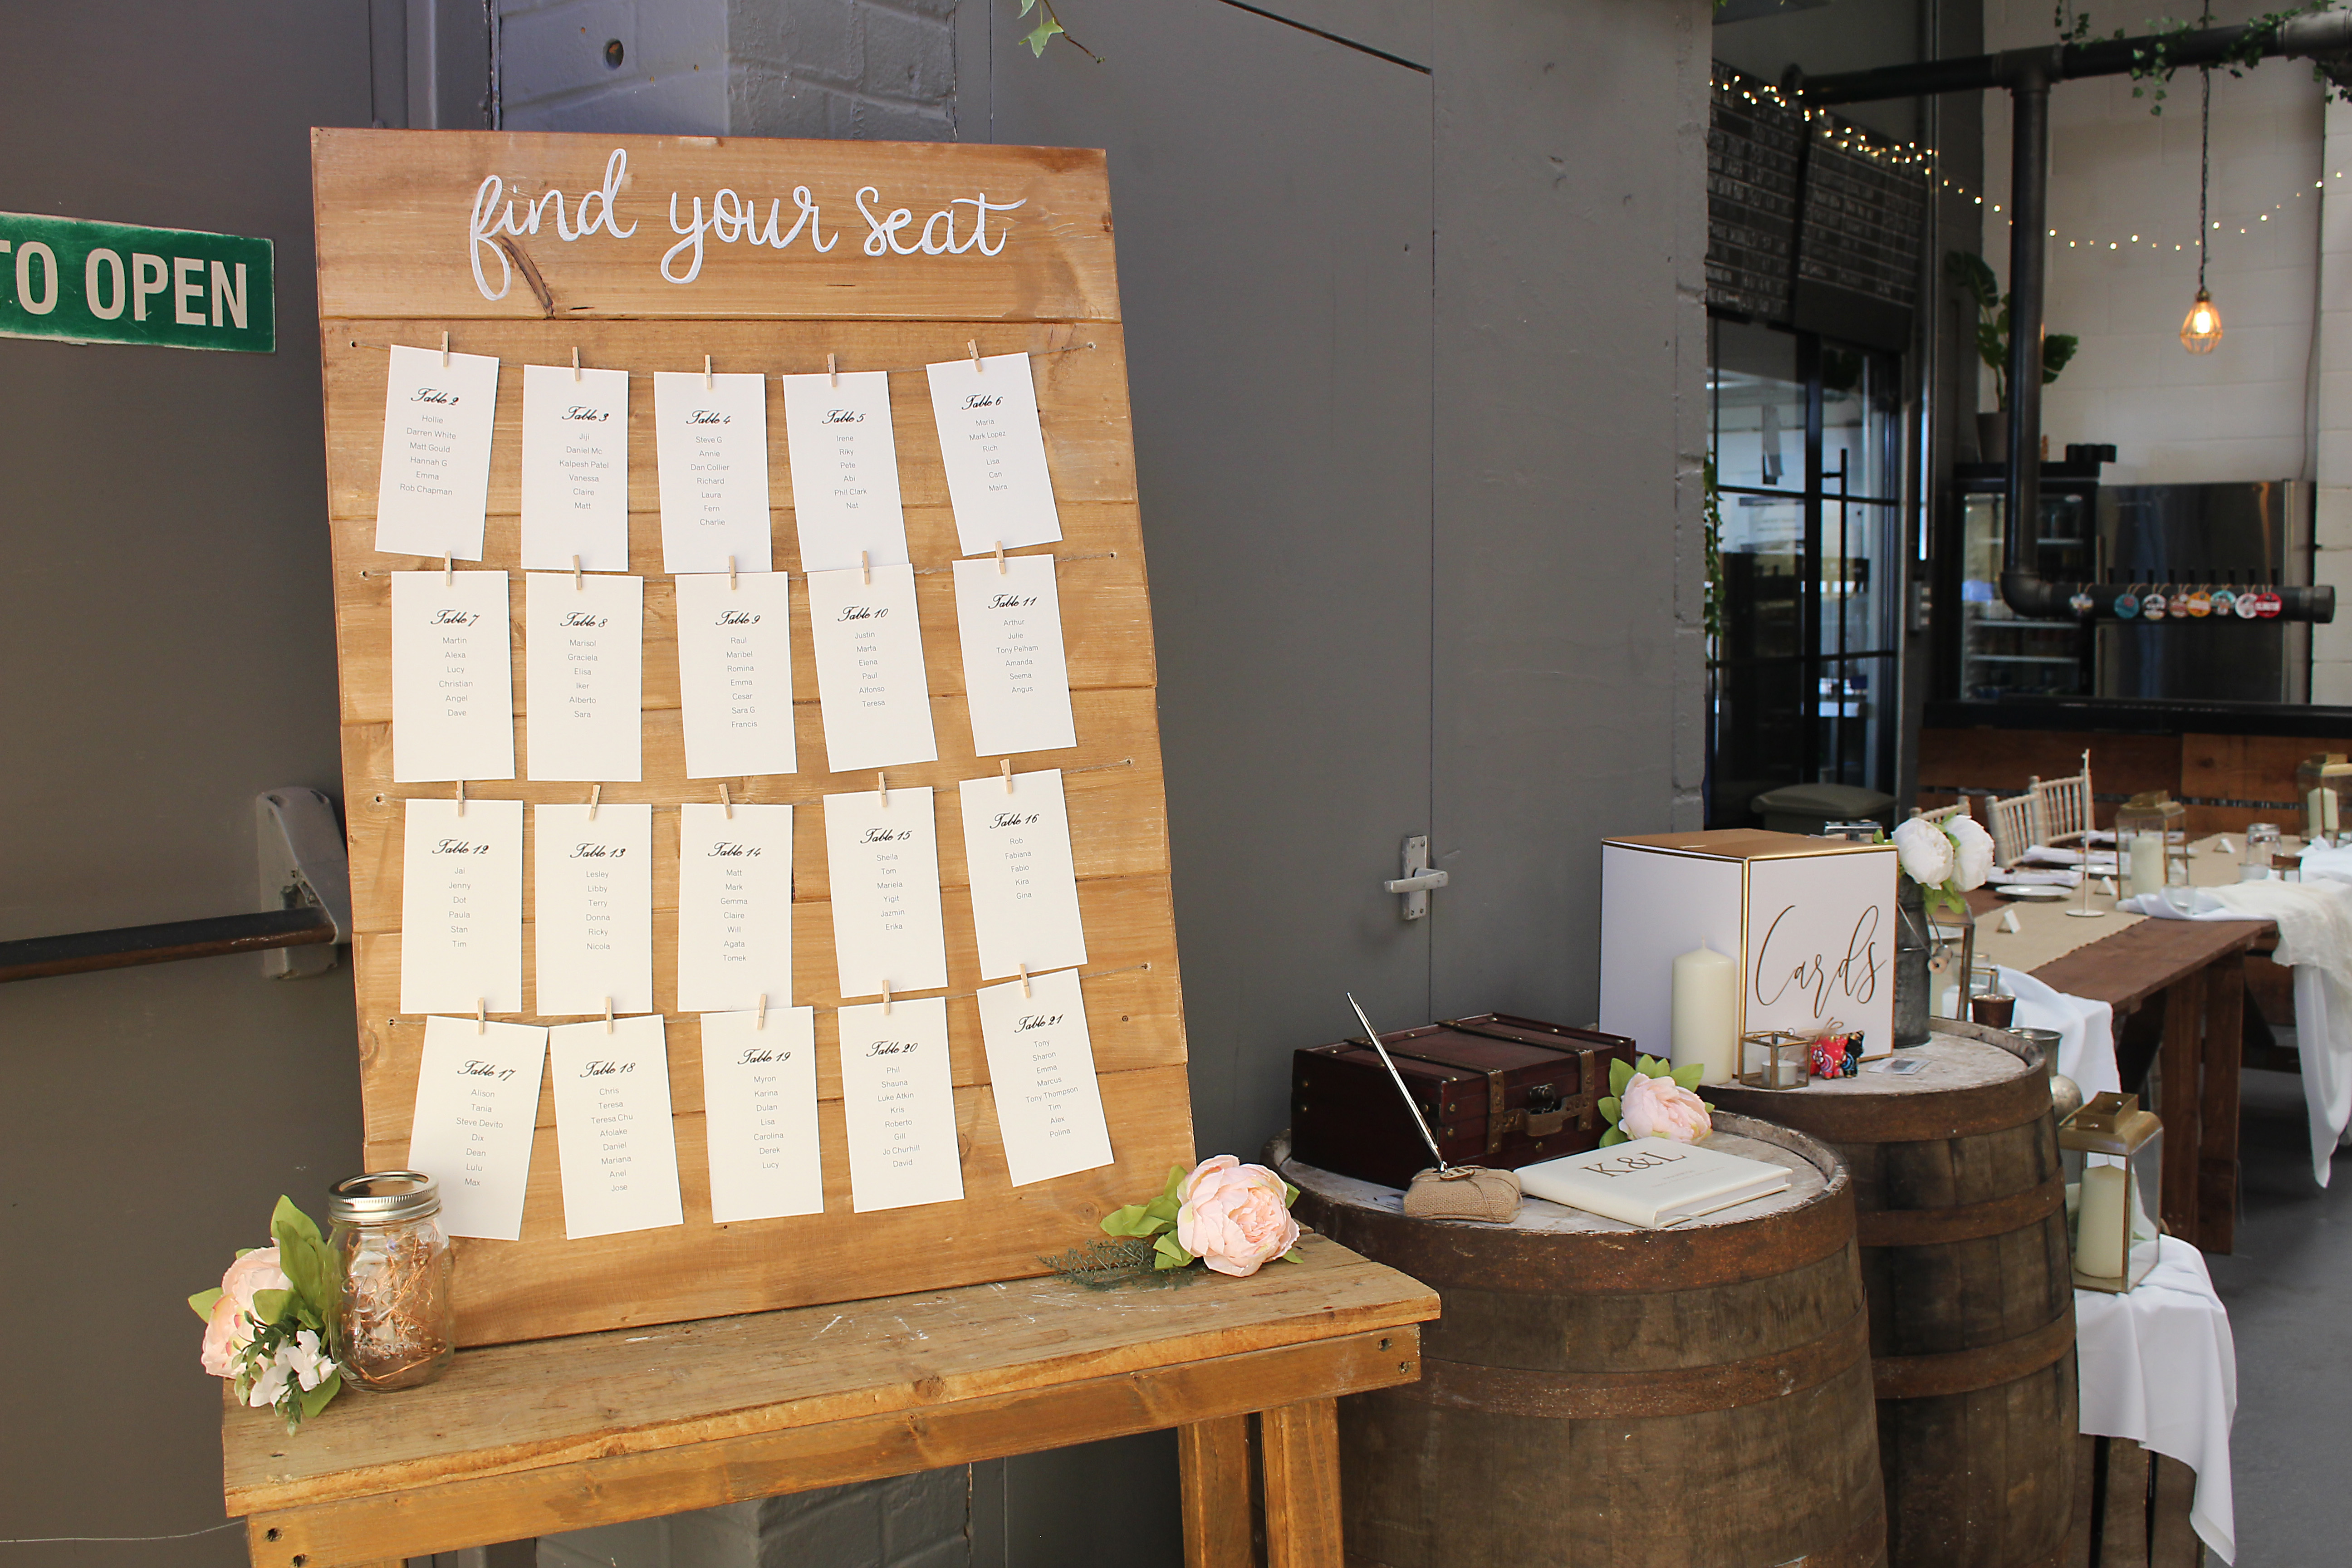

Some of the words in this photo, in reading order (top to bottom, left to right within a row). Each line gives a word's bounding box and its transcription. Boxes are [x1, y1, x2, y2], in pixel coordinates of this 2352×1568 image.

[470, 148, 638, 300] find
[661, 185, 838, 284] your
[85, 248, 248, 328] OPEN
[410, 387, 448, 404] Table
[448, 397, 460, 406] 2
[961, 393, 993, 411] Table
[995, 396, 1004, 406] 6
[561, 406, 598, 421] Table
[598, 413, 609, 422] 3
[686, 410, 720, 425] Table
[722, 415, 731, 425] 4
[822, 409, 855, 424] Table
[856, 413, 867, 423] 5
[975, 418, 995, 426] Maria
[407, 427, 432, 436] Darren
[434, 430, 456, 440] White
[969, 433, 986, 441] Mark
[566, 446, 589, 454] Daniel
[839, 448, 854, 456] Riky
[982, 444, 998, 452] Rich
[559, 460, 589, 468] Kalpesh
[568, 474, 599, 482] Vanessa
[400, 483, 415, 491] Rob
[416, 485, 453, 495] Chapman
[988, 593, 1020, 609] Table
[1023, 596, 1038, 607] 11
[431, 609, 467, 625] Table
[468, 613, 480, 627] 7
[715, 610, 750, 626] Table
[751, 615, 761, 624] 9
[837, 605, 871, 622] Table
[874, 608, 889, 618] 10
[559, 612, 596, 627] Table
[598, 618, 608, 628] 8
[569, 639, 596, 647] Marisol
[1005, 658, 1033, 667] Amanda
[859, 686, 885, 694] Alfonso
[445, 694, 468, 703] Angel
[989, 812, 1022, 829] Table
[1024, 813, 1040, 824] 16
[860, 827, 894, 844] Table
[897, 830, 913, 841] 15
[431, 838, 470, 854] Table
[472, 844, 490, 855] 12
[569, 843, 606, 858] Table
[609, 848, 626, 858] 13
[707, 842, 743, 857] Table
[746, 848, 762, 857] 14
[877, 853, 898, 862] Sheila
[1005, 851, 1032, 860] Fabiana
[1011, 864, 1029, 872] Fabio
[586, 871, 609, 879] Lesley
[448, 882, 471, 890] Jenny
[588, 885, 608, 893] Libby
[877, 881, 903, 889] Mariela
[883, 895, 900, 903] Yigit
[880, 909, 905, 917] Jazmin
[588, 928, 608, 937] Ricky
[723, 940, 745, 949] Agata
[1755, 905, 1887, 1019] Cards
[1014, 1014, 1046, 1033] Table
[1047, 1014, 1064, 1026] 21
[866, 1040, 900, 1057] Table
[901, 1042, 918, 1054] 20
[737, 1048, 773, 1065] Table
[775, 1051, 791, 1062] 19
[1032, 1052, 1056, 1062] Sharon
[457, 1060, 496, 1077] Table
[498, 1068, 517, 1082] 17
[579, 1060, 617, 1078] Table
[619, 1062, 636, 1073] 18
[1036, 1065, 1058, 1074] Emma
[754, 1076, 776, 1084] Myron
[881, 1080, 908, 1088] Shauna
[1037, 1077, 1062, 1087] Marcus
[470, 1088, 495, 1098] Alison
[1025, 1095, 1042, 1103] Tony
[1043, 1087, 1078, 1099] Thompson
[471, 1103, 492, 1112] Tania
[456, 1117, 477, 1126] Steve
[479, 1119, 503, 1128] Devito
[885, 1119, 912, 1128] Roberto
[600, 1128, 627, 1137] Afolake
[754, 1132, 784, 1141] Carolina
[1049, 1129, 1071, 1138] Polina
[603, 1142, 627, 1151] Daniel
[759, 1146, 780, 1155] Derek
[892, 1144, 920, 1154] Churhill
[466, 1148, 486, 1156] Dean
[601, 1156, 632, 1165] Mariana
[1579, 1151, 1687, 1177] K&L
